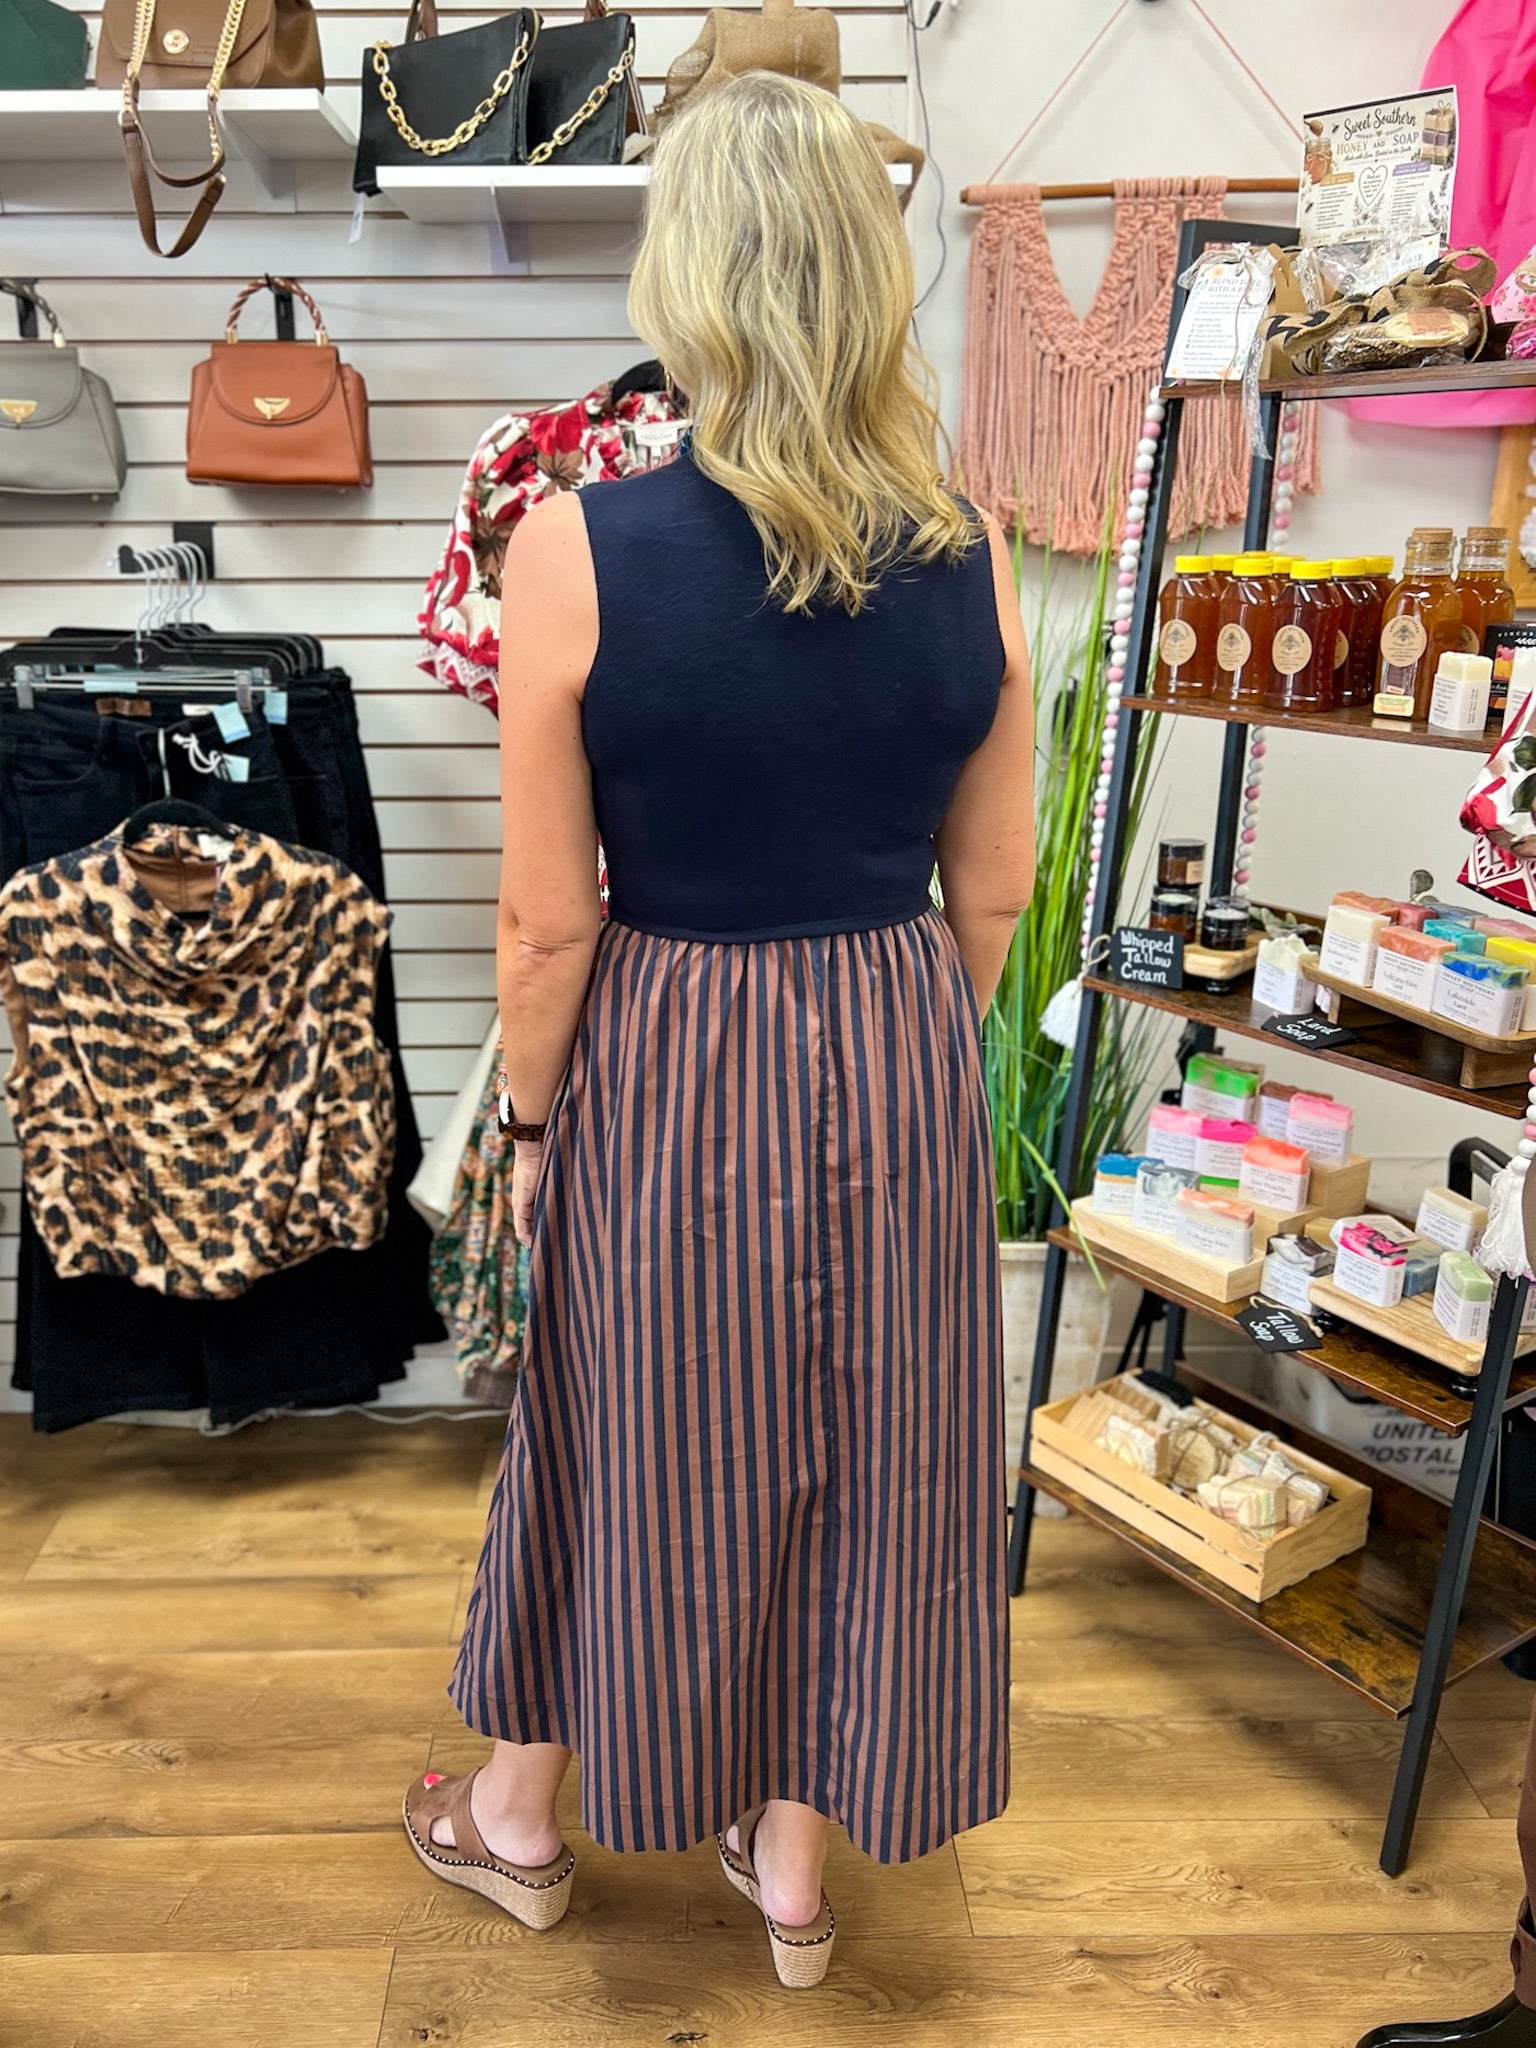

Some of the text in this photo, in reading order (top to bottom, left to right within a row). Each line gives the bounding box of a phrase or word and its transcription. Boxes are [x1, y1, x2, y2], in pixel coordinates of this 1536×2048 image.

[1343, 107, 1416, 141] Sweet Southern
[1336, 132, 1419, 155] HONEY AND SOAP
[1121, 930, 1174, 954] Whipped
[1121, 947, 1172, 968] Tallow
[1121, 961, 1168, 985] Cream
[1276, 1023, 1317, 1041] Soap
[1297, 1017, 1342, 1035] Lard
[1249, 1321, 1275, 1341] Soap
[1266, 1311, 1305, 1344] Tallow
